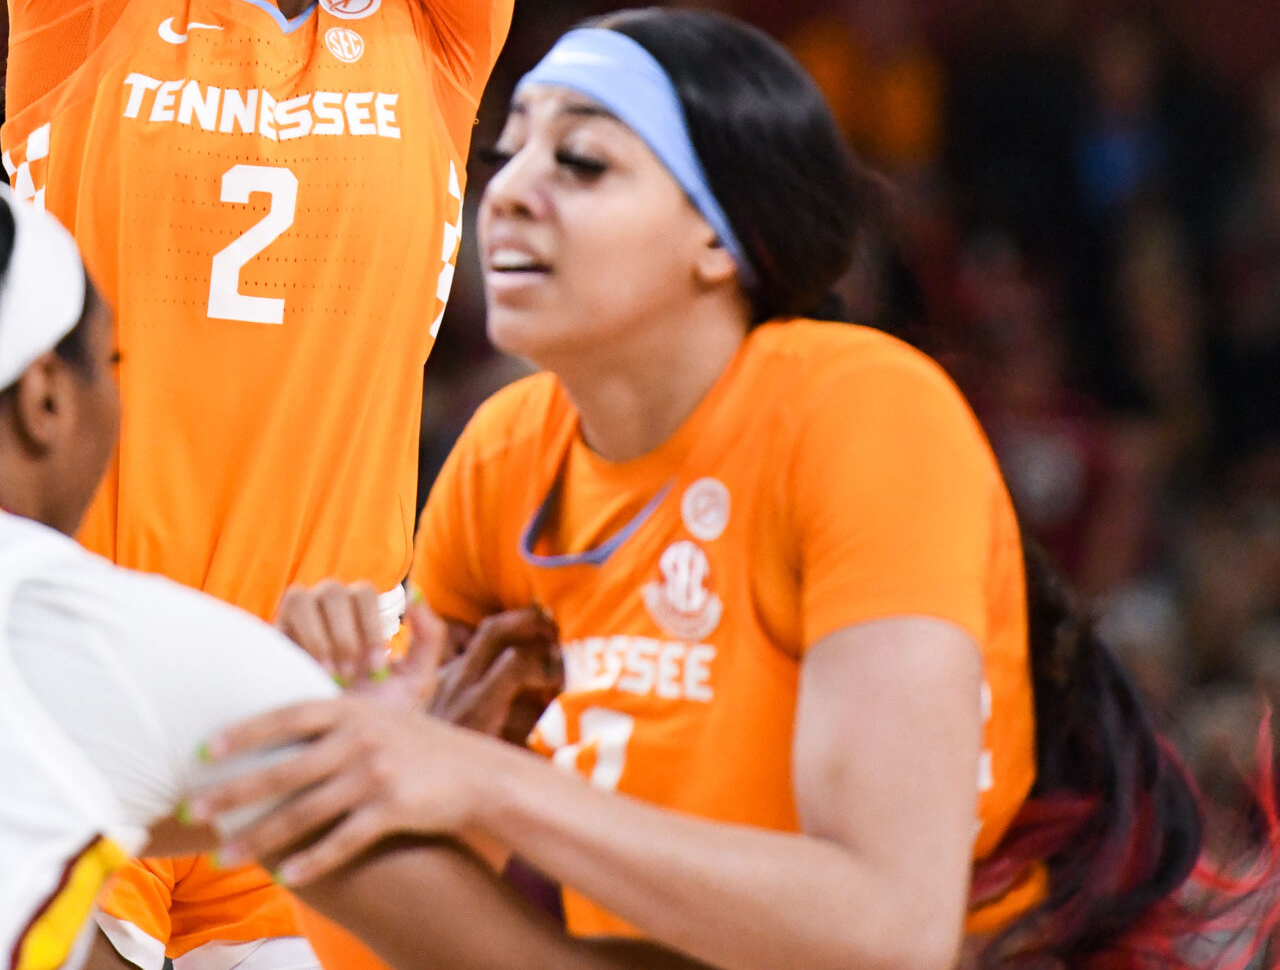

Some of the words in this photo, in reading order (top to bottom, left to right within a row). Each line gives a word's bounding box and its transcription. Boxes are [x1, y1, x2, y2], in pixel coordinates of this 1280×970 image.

[327, 28, 362, 61] SEC
[123, 72, 401, 141] TENNESSEE
[207, 164, 299, 325] 2
